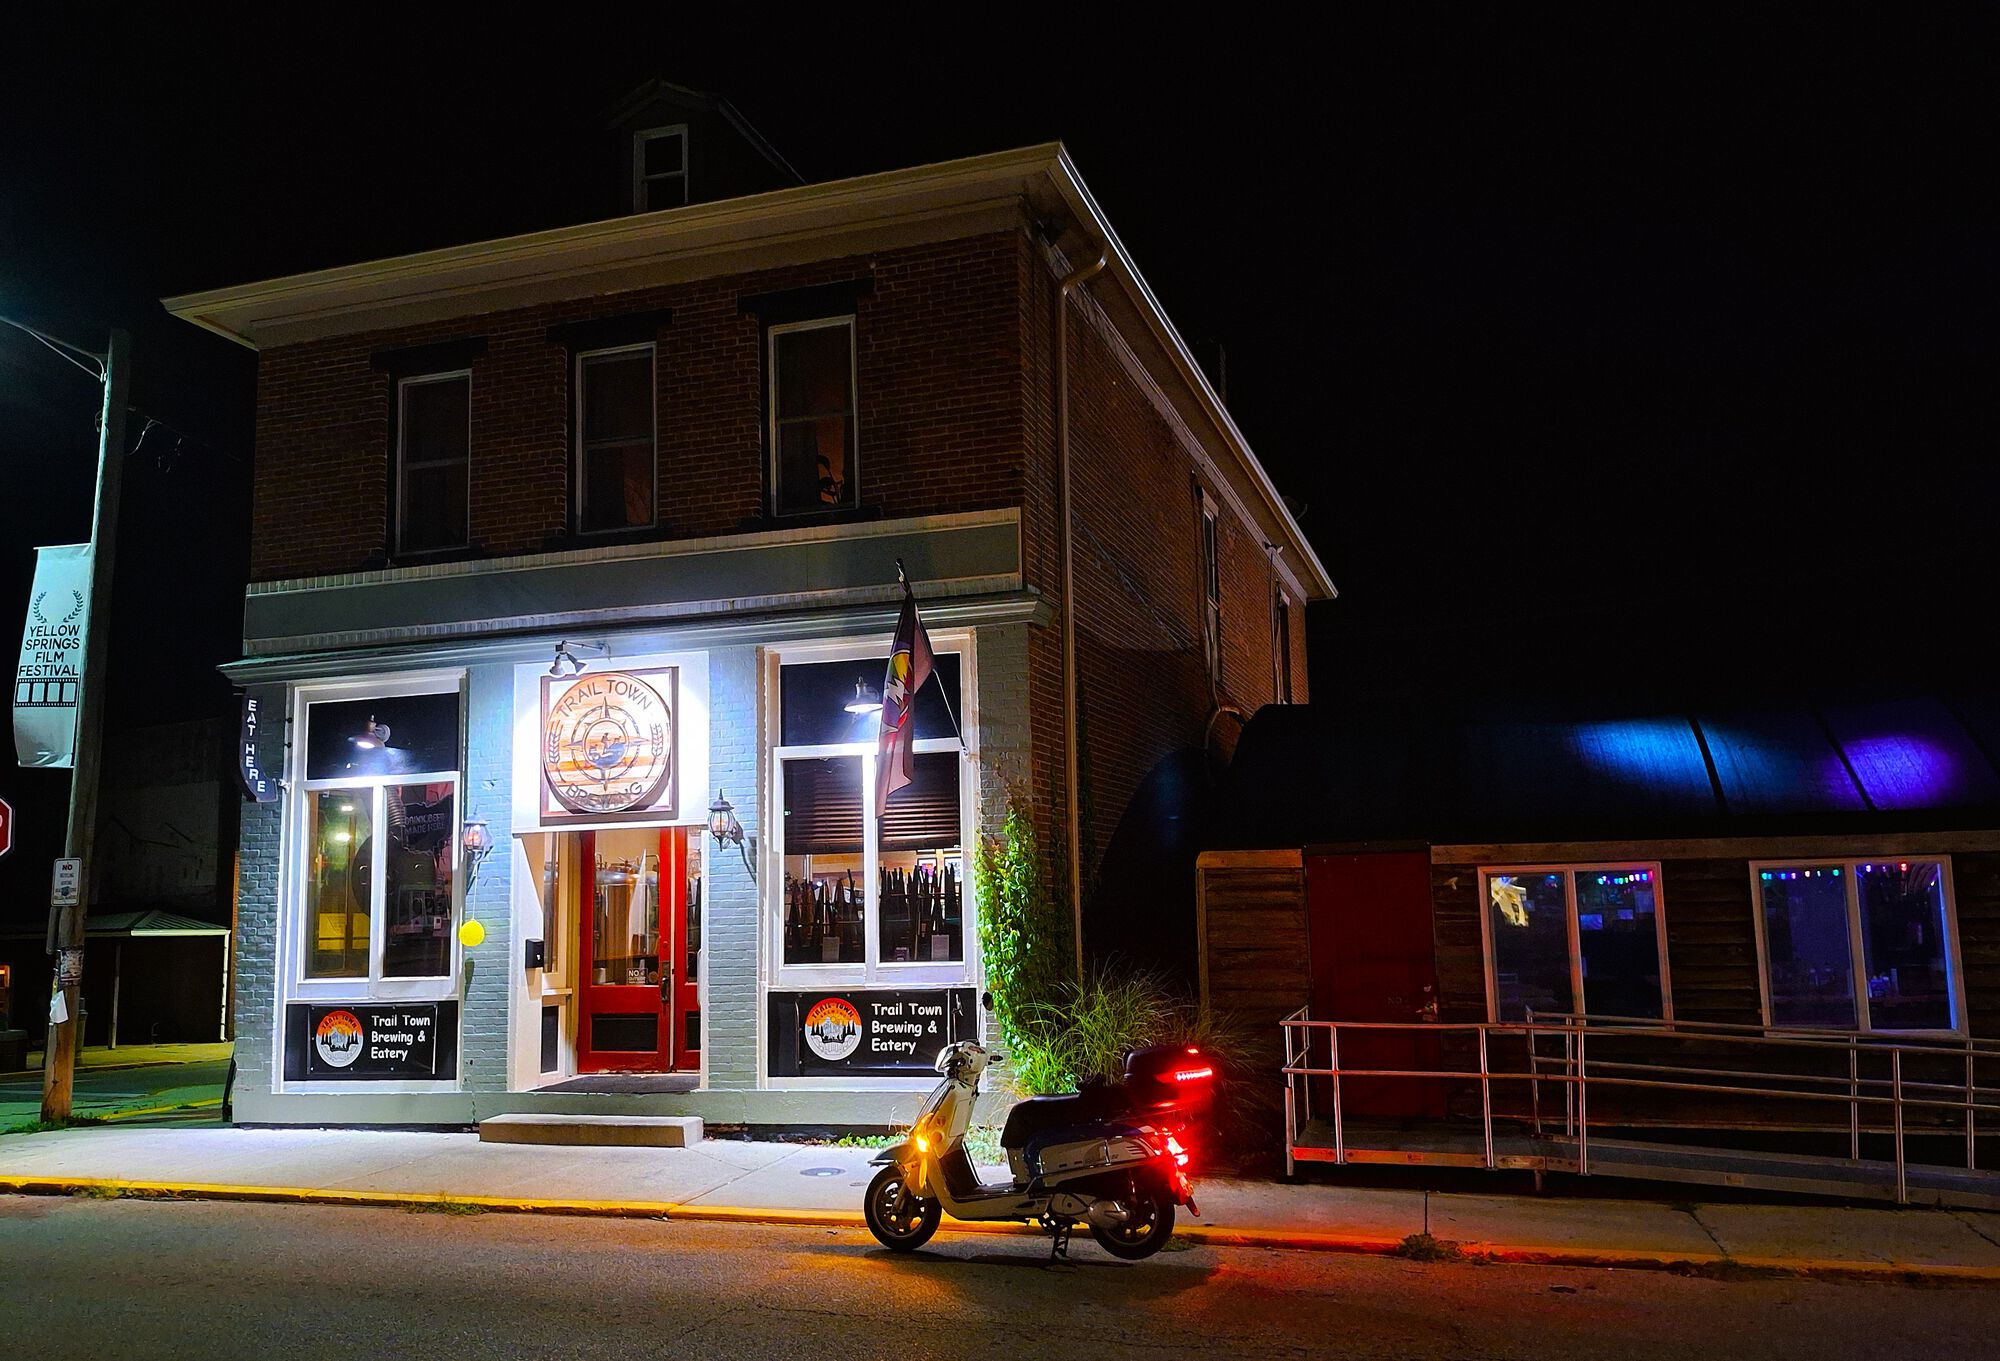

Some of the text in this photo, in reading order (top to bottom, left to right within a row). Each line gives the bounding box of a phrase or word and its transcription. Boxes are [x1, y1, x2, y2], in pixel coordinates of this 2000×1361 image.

[30, 624, 80, 637] YELLOW
[25, 637, 80, 650] SPRINGS
[35, 651, 64, 663] FILM
[19, 664, 79, 677] FESTIVAL
[556, 679, 653, 717] TRAIL TOWN
[245, 700, 266, 792] EAT HERE
[812, 1003, 854, 1019] TRAIL TOWN
[871, 1002, 943, 1016] Trail Town
[371, 1014, 431, 1027] Trail Town
[871, 1020, 938, 1037] Brewing &
[371, 1030, 426, 1046] Brewing &
[871, 1037, 917, 1055] Eatery
[371, 1046, 408, 1062] Eatery
